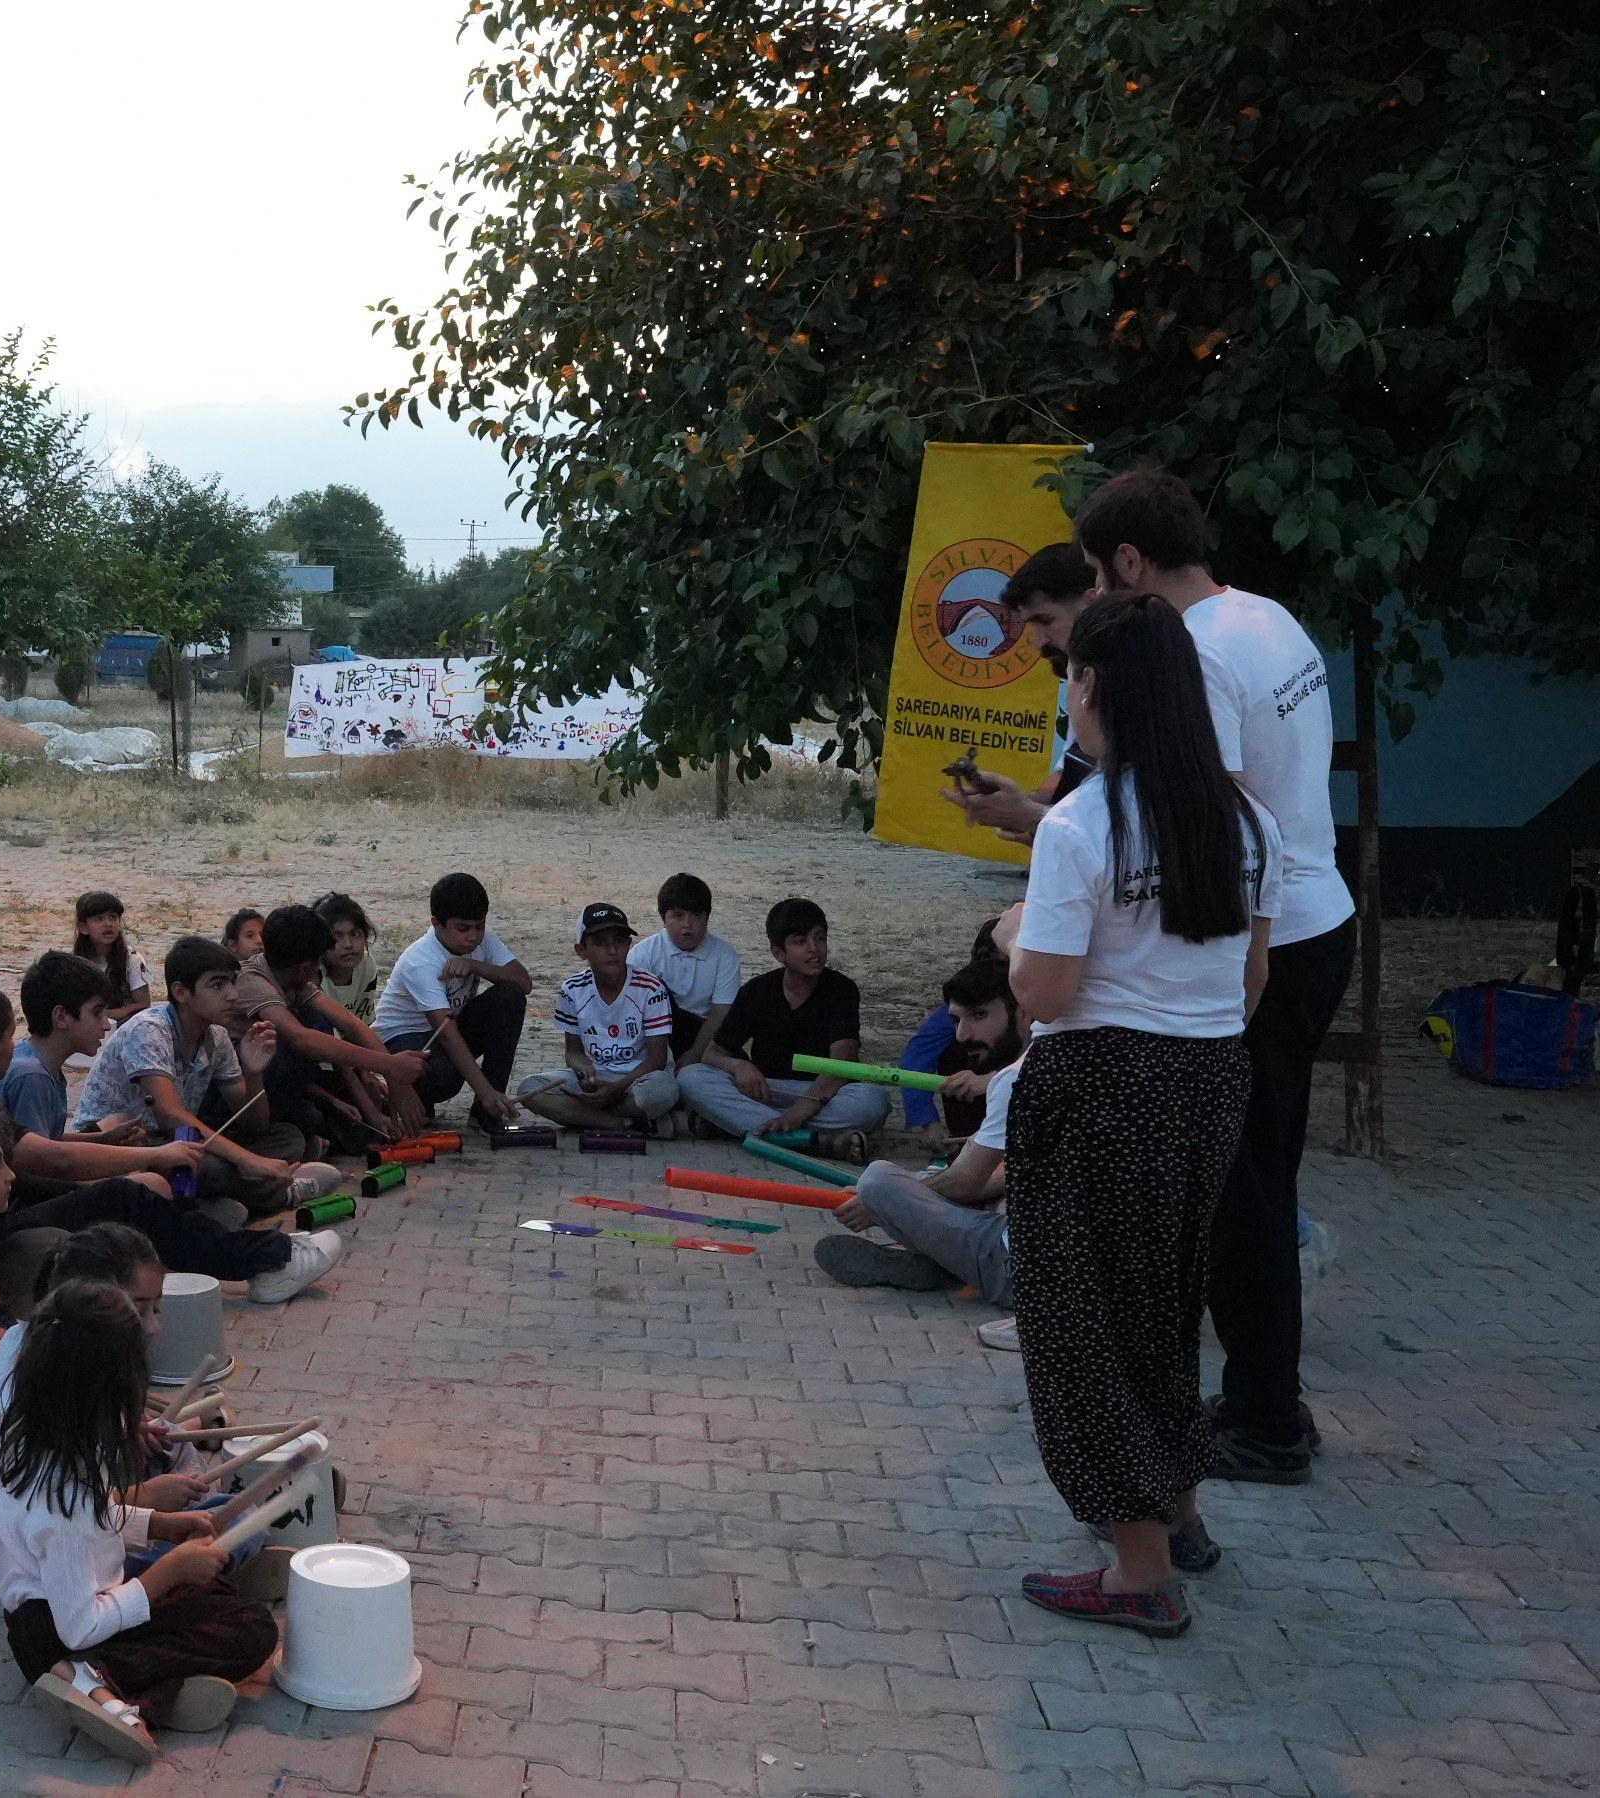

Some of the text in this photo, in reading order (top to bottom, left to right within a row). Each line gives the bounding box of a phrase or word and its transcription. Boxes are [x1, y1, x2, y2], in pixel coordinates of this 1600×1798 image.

[960, 634, 988, 647] 1880
[893, 717, 1045, 753] SİLVAN BELEDİYESİ
[590, 1043, 635, 1061] beko
